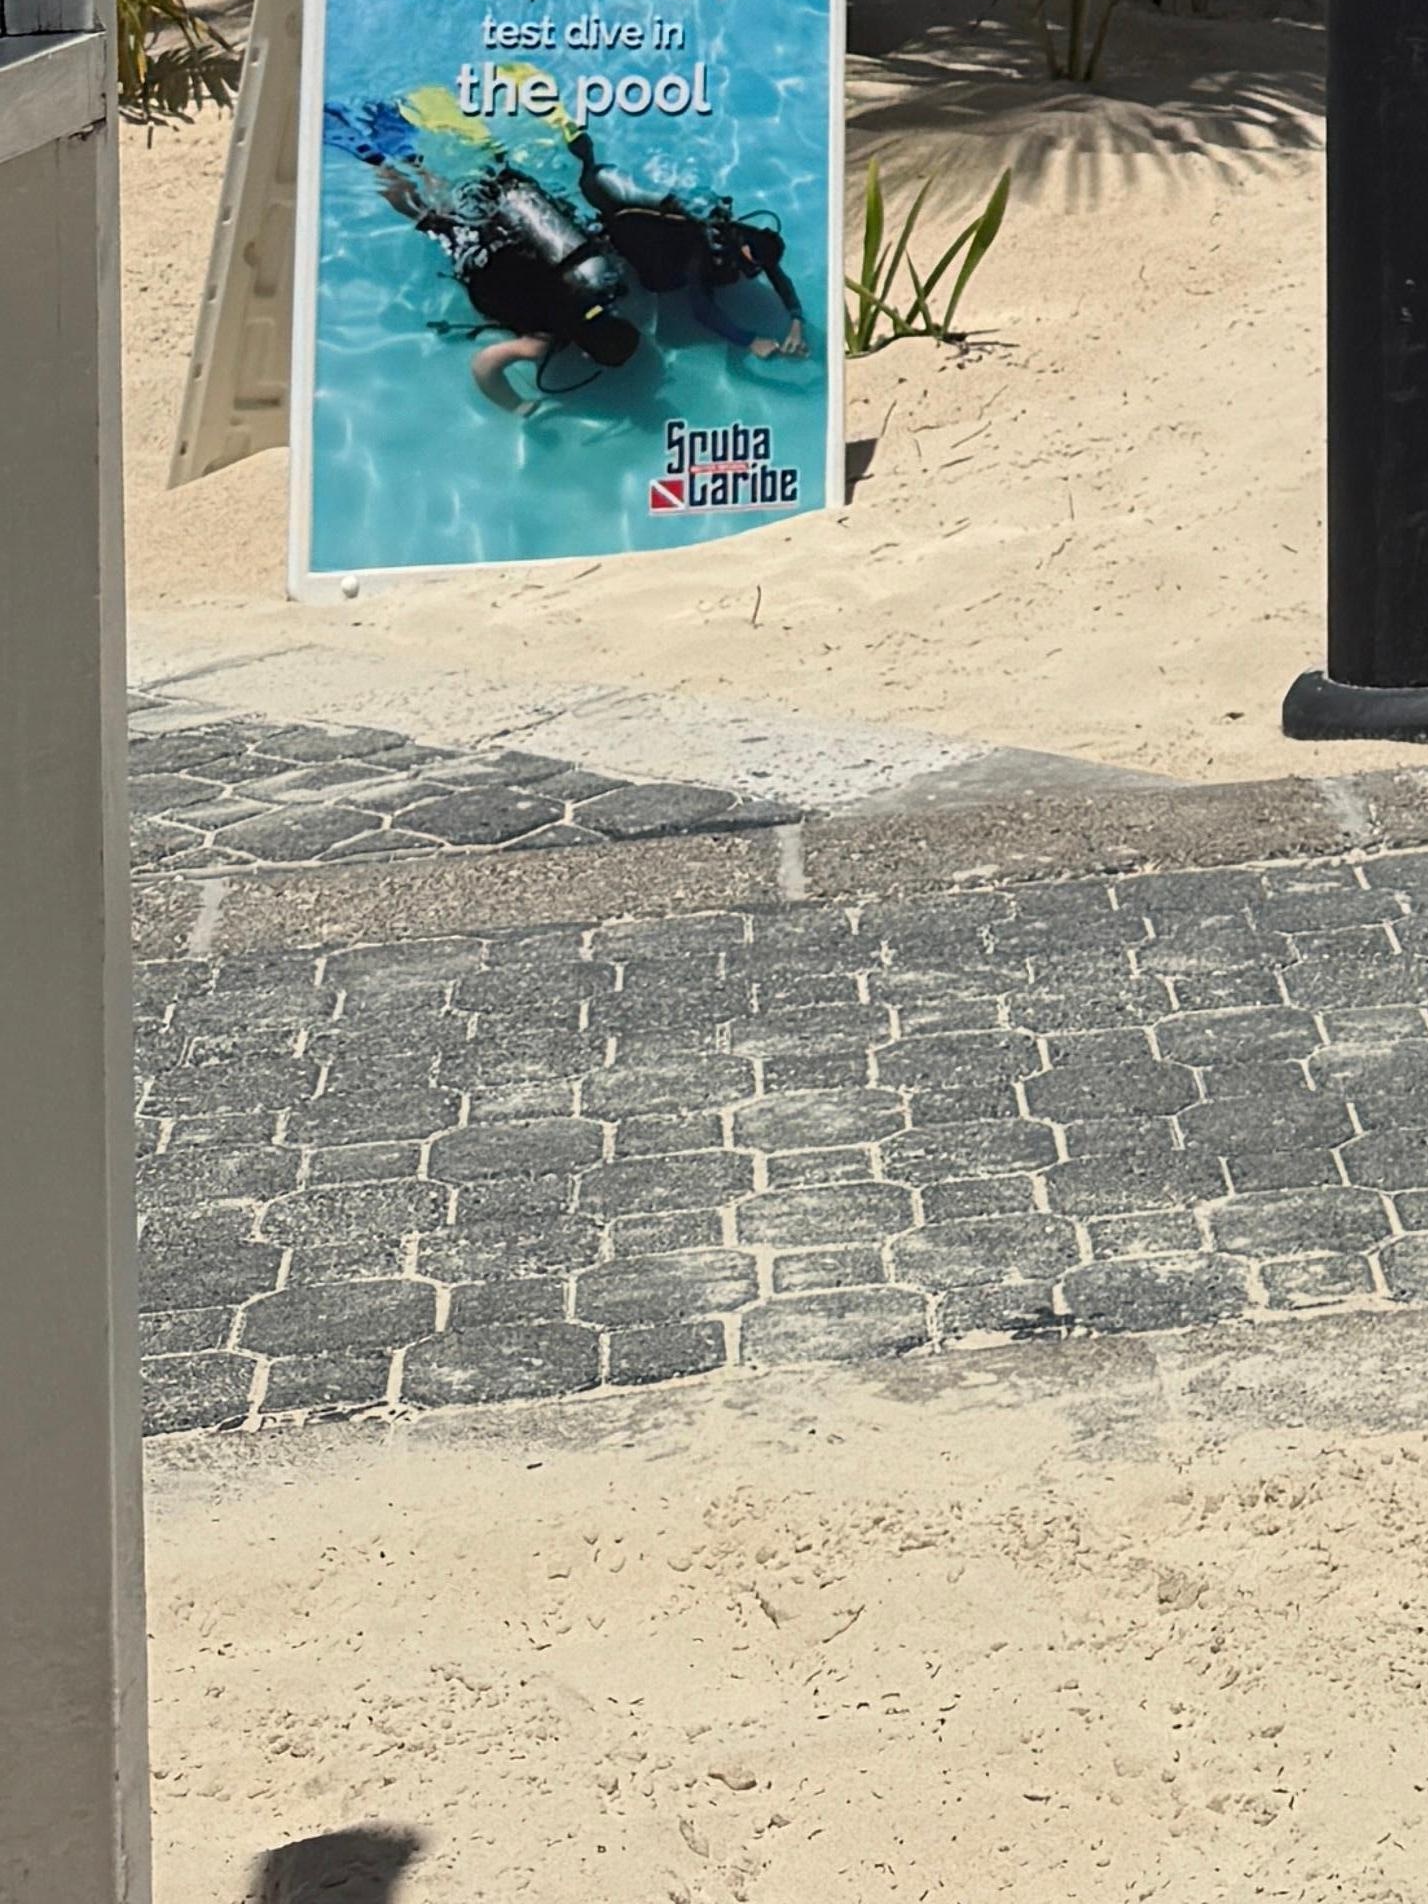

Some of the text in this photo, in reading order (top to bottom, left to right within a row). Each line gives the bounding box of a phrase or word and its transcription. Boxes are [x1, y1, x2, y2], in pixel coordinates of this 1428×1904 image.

[482, 14, 686, 50] test dive in
[456, 61, 713, 130] the pool
[667, 421, 770, 474] Scuba
